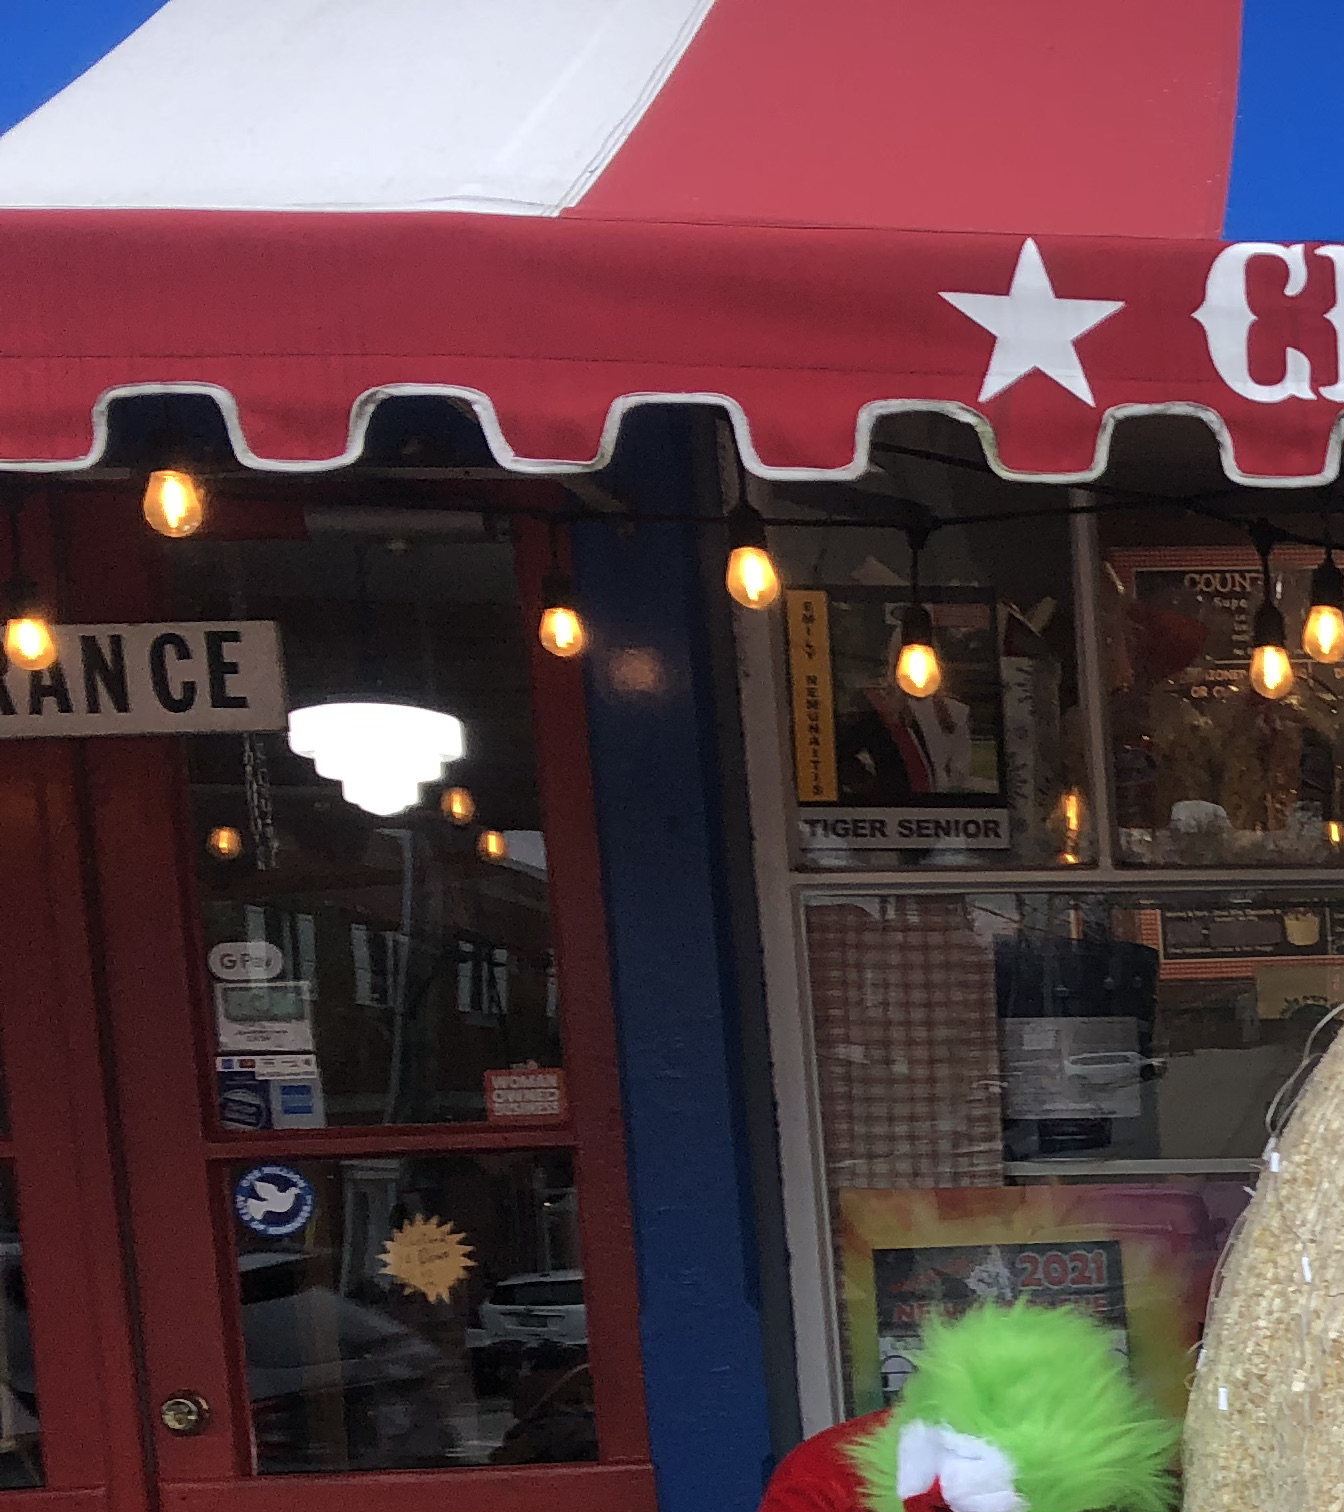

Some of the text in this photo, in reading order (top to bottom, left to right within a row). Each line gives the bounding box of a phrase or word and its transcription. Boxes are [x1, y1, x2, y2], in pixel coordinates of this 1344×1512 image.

[0, 630, 249, 715] ANCE
[802, 818, 1002, 839] TIGER SENIOR
[1016, 1250, 1108, 1289] 2021
